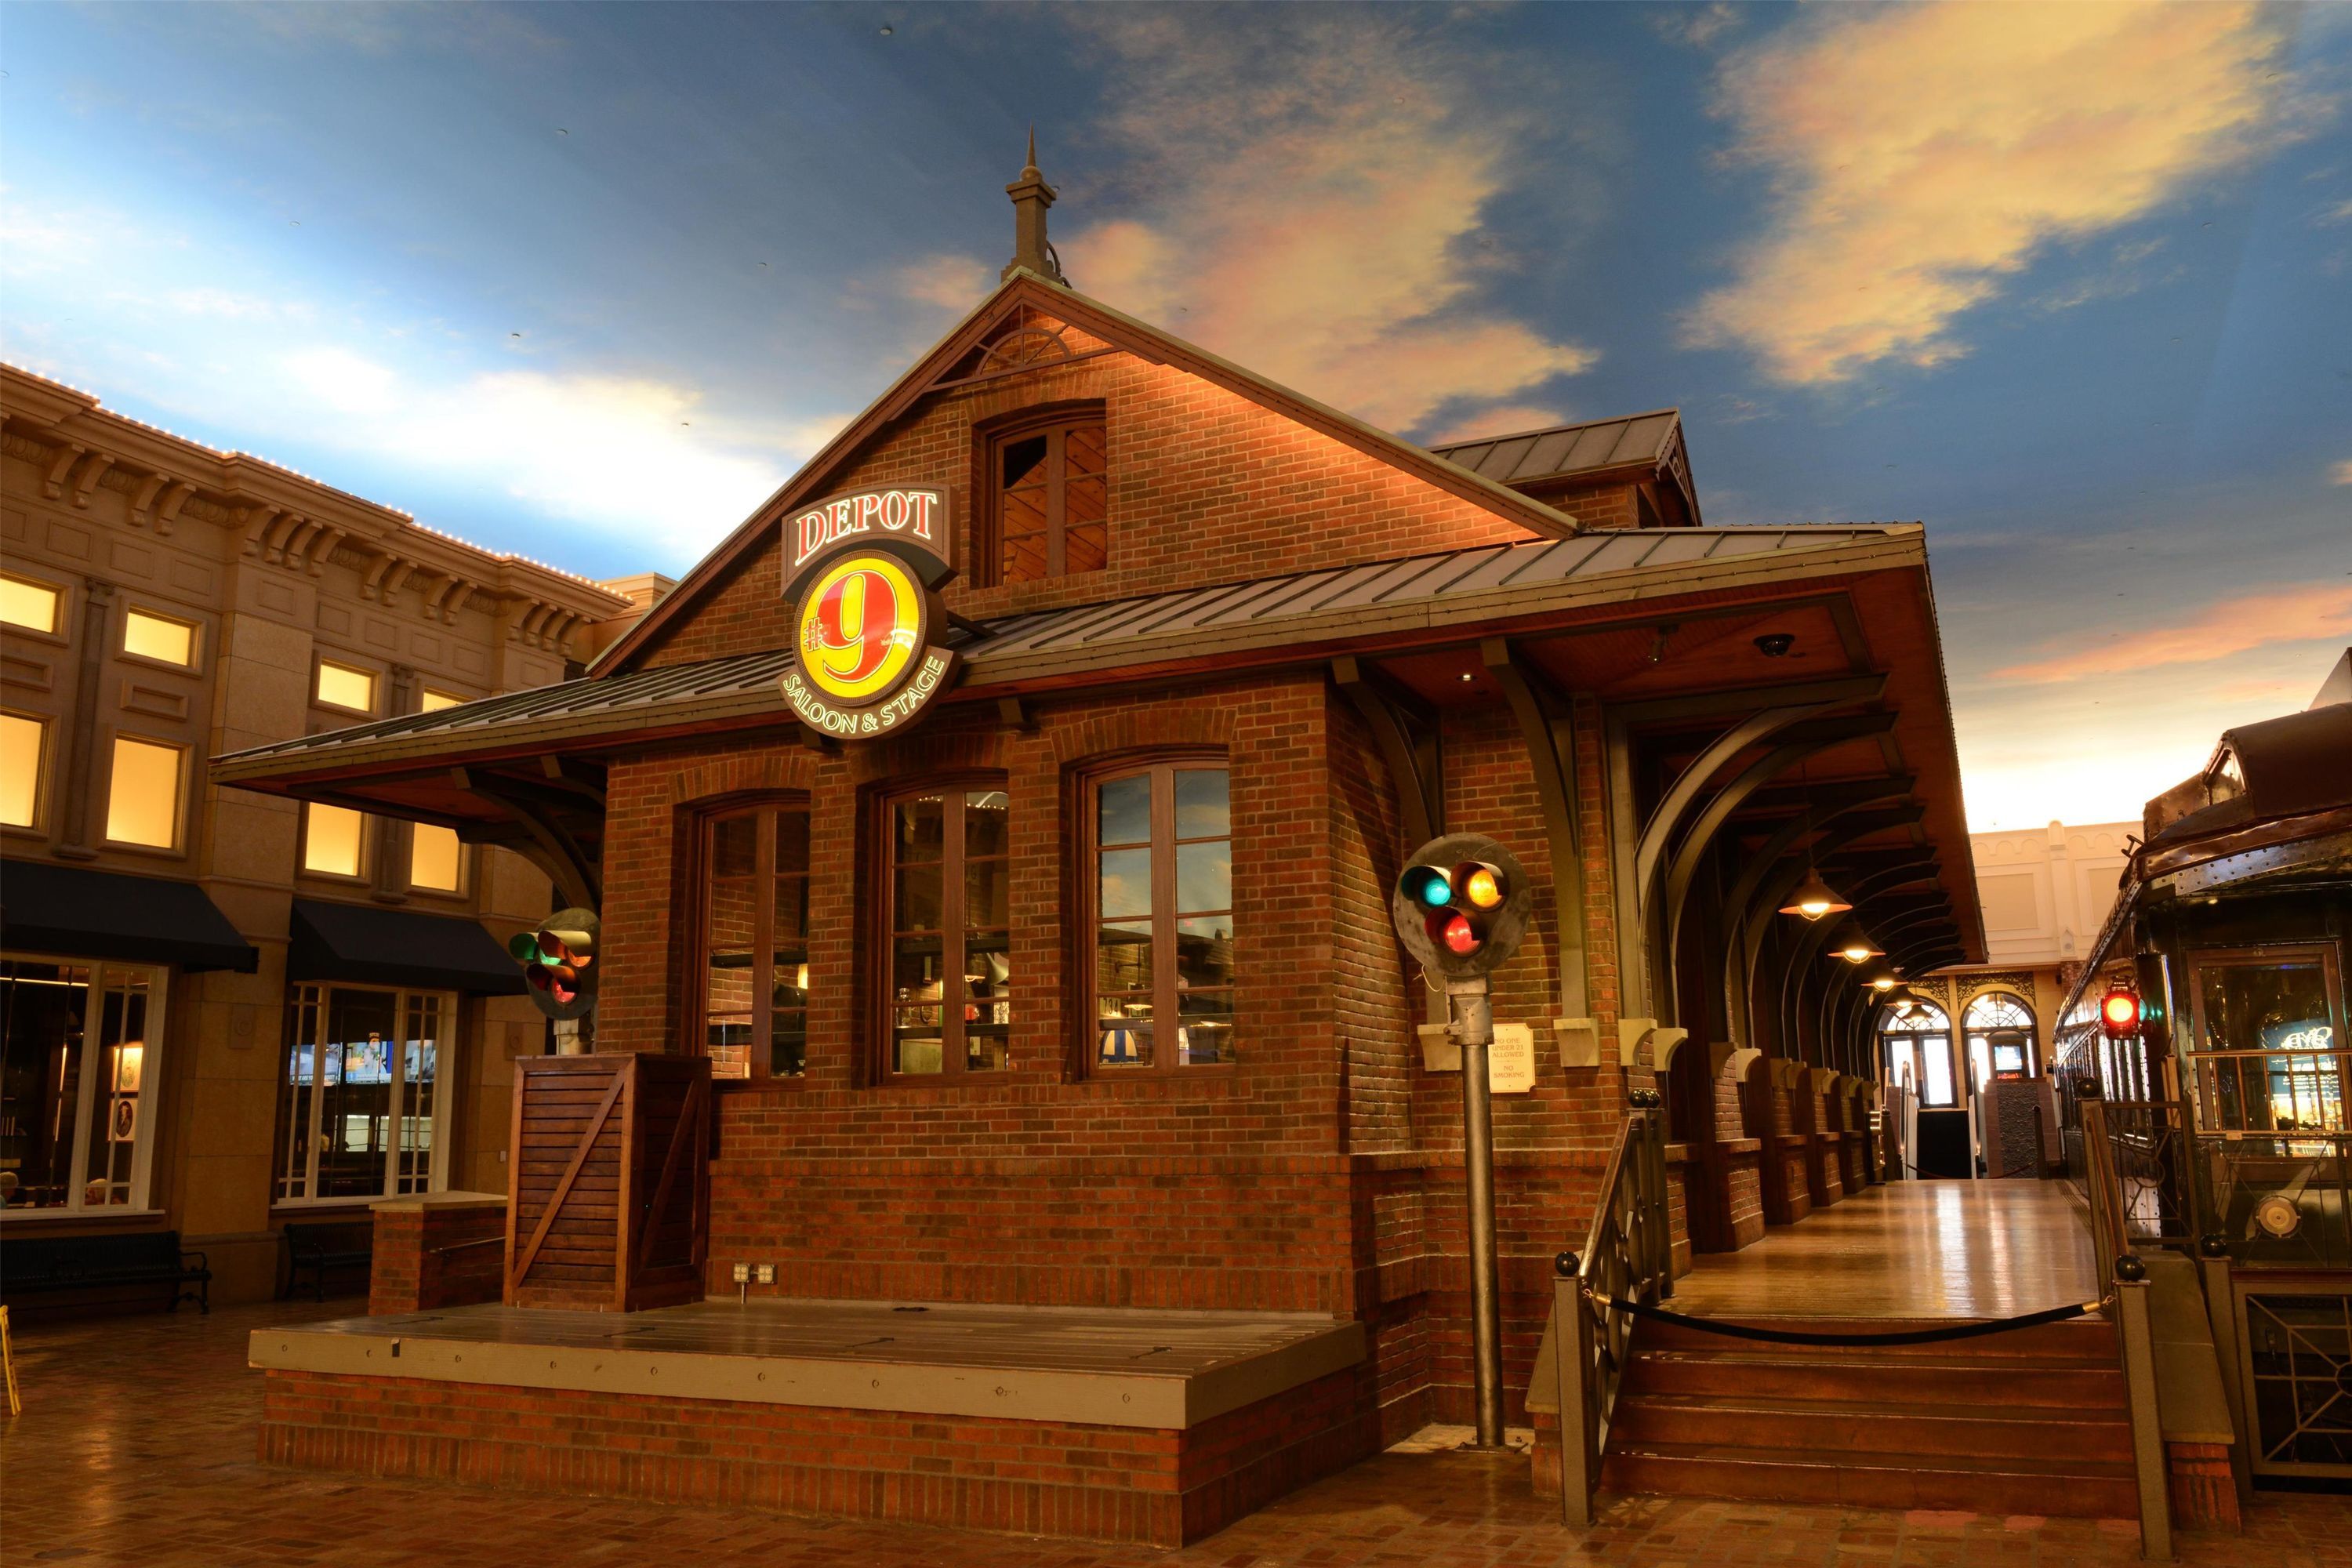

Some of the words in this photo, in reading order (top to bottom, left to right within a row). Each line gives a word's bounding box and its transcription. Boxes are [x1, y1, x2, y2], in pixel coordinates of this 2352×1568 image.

[794, 491, 938, 566] DEPOT
[782, 674, 858, 734] SALOON
[862, 714, 879, 734] &
[880, 655, 945, 727] STAGE
